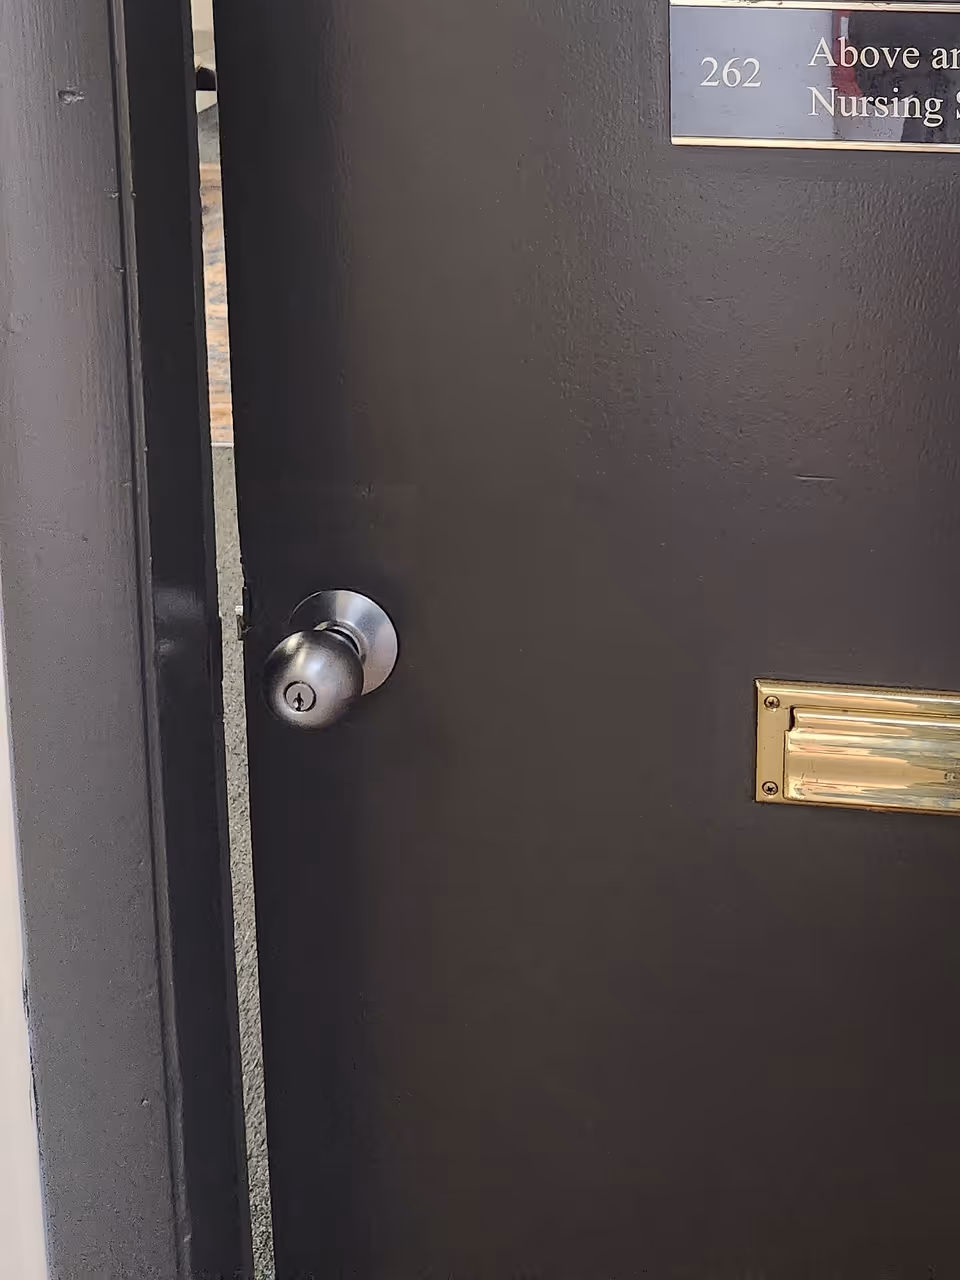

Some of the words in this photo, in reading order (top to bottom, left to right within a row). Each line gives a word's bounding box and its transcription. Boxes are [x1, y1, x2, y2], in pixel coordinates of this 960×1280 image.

[807, 35, 921, 71] Above
[700, 55, 763, 88] 262
[808, 87, 944, 128] Nursing
